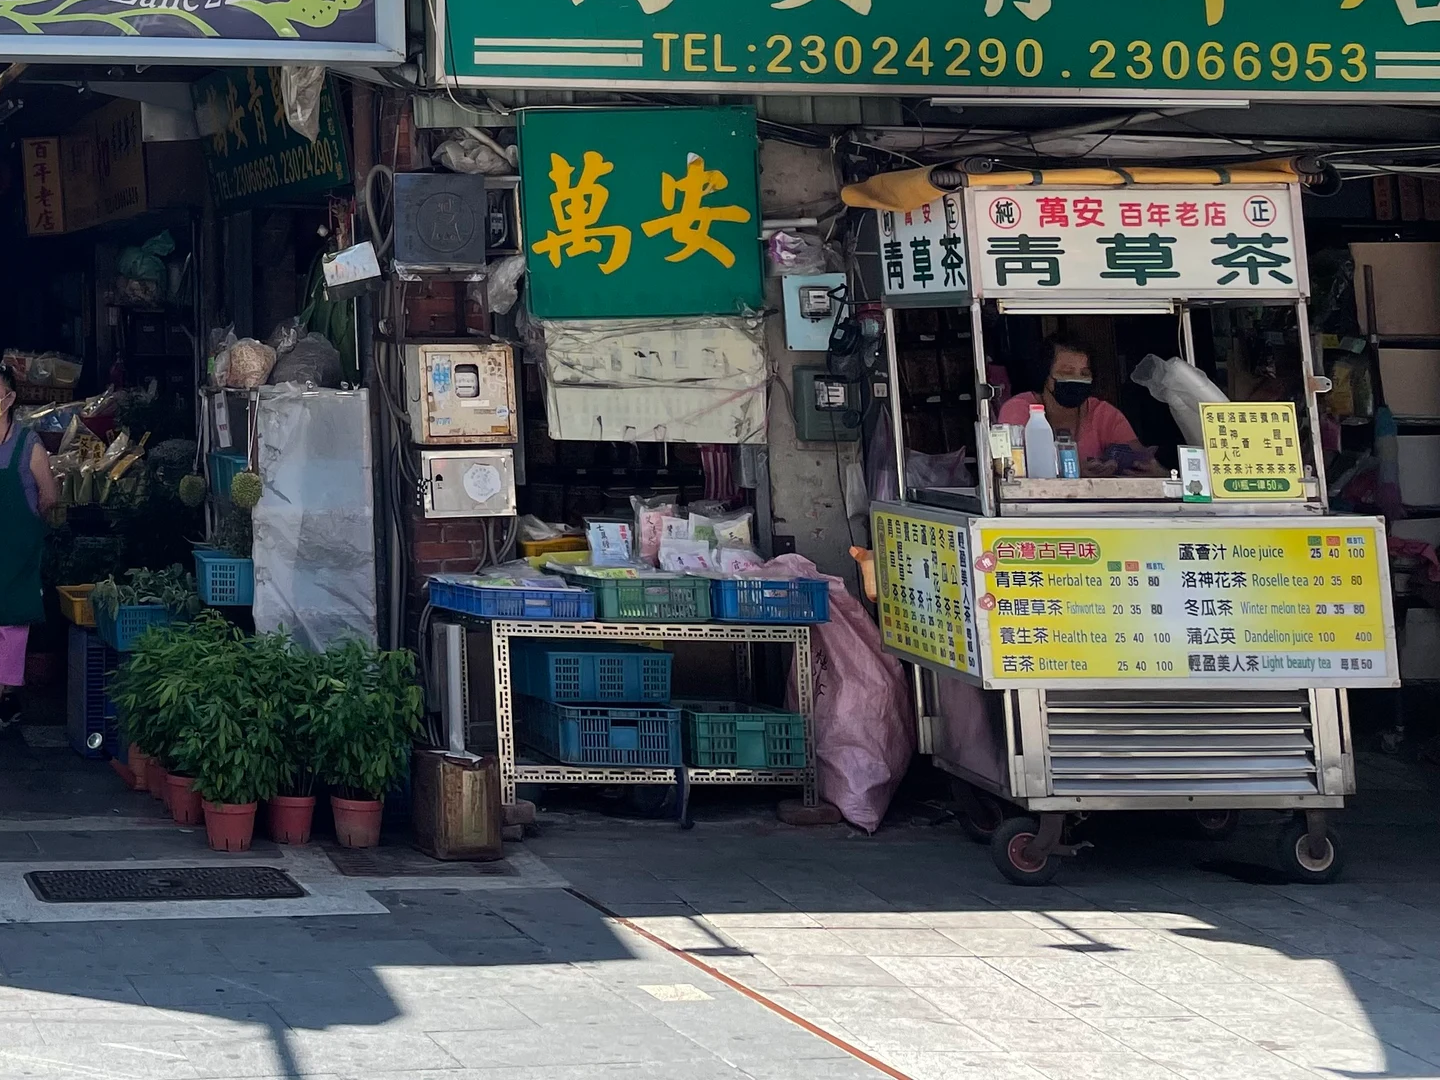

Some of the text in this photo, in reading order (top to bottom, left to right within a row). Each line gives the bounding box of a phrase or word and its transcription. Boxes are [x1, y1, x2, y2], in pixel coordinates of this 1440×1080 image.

[531, 150, 752, 275] 萬安
[1035, 196, 1105, 228] 萬安
[1119, 202, 1226, 227] 百年老店
[883, 233, 966, 290] 青草茶
[986, 232, 1293, 287] 青草茶
[996, 543, 1099, 560] 台灣古早味
[1232, 545, 1256, 558] Aloe
[1258, 545, 1284, 561] juice
[1310, 548, 1322, 558] 25
[1329, 548, 1339, 558] 40
[1348, 548, 1365, 558] 100
[995, 571, 1102, 588] 青草茶 Herbal tea
[1181, 571, 1309, 588] 洛神花茶 Roselle tea
[997, 598, 1063, 616] 魚腥草茶
[1067, 601, 1094, 614] Fishwort
[1095, 603, 1105, 614] tea
[1112, 604, 1124, 615] 20
[1130, 604, 1141, 615] 35
[1151, 604, 1163, 614] 80
[1184, 598, 1310, 617] 冬瓜茶 Winter melon tea
[1000, 627, 1107, 645] 養生茶 Health tea
[1186, 627, 1372, 645] 蒲公英 Dandelion juice 100 400
[1002, 655, 1087, 672] 苦茶 Bitter tea
[1262, 655, 1284, 671] Light
[1287, 655, 1315, 672] beauty
[1318, 657, 1332, 669] tea
